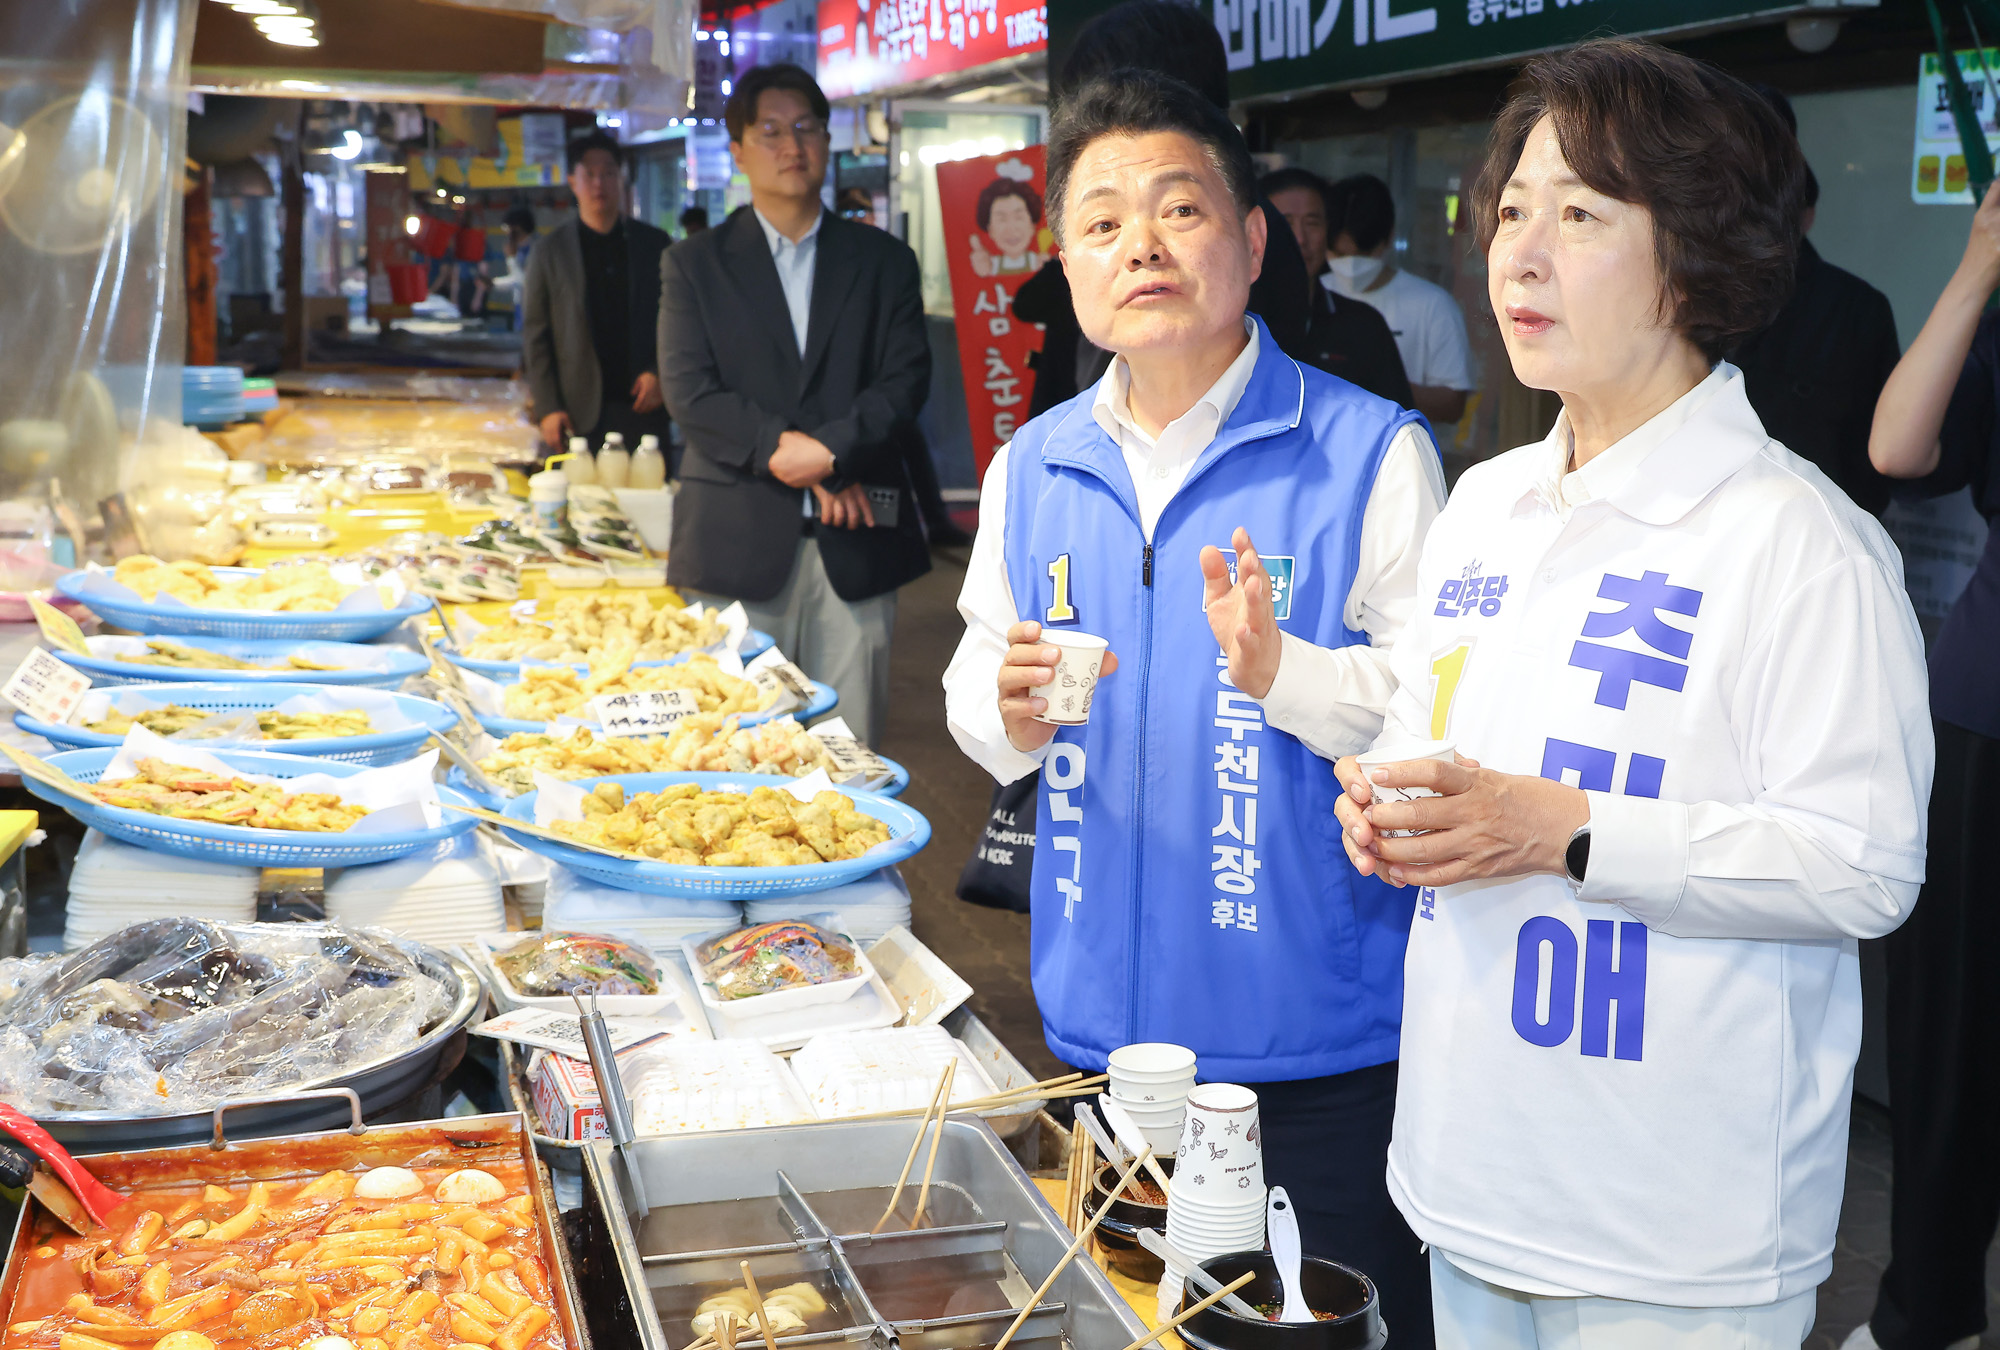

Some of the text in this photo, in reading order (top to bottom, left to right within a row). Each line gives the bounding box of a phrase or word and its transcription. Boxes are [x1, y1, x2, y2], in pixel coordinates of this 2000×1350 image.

[1046, 553, 1079, 626] 1
[1434, 575, 1509, 618] 민주당
[650, 691, 682, 706] 튀김
[1428, 635, 1479, 741] 1
[992, 807, 1015, 826] ALL
[1211, 899, 1259, 932] 후보
